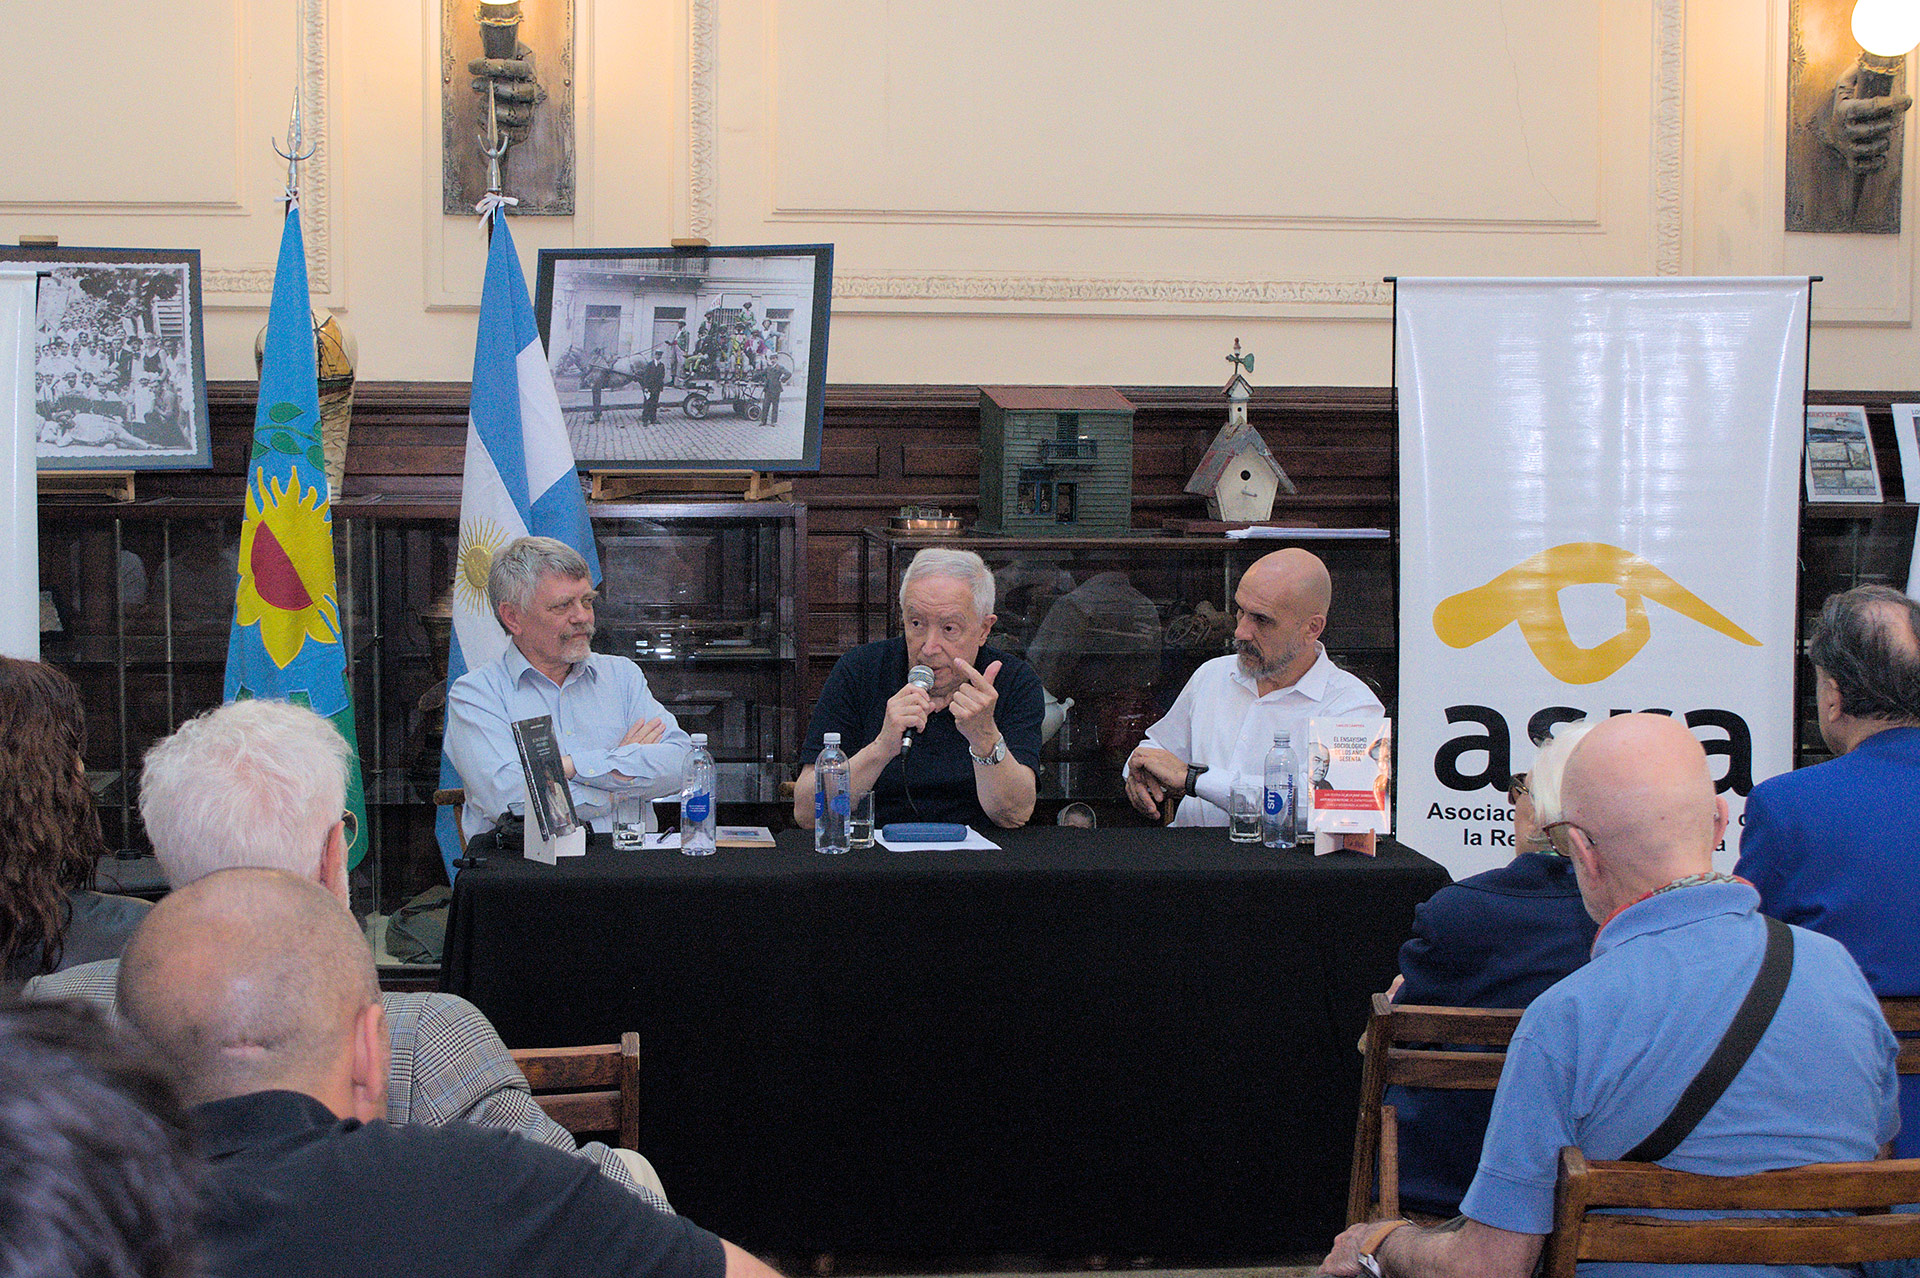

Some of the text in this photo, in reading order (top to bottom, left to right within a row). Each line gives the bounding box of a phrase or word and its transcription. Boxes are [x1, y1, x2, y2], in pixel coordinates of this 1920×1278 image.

[1434, 704, 1754, 797] asa
[1427, 802, 1516, 821] Asociac
[1463, 828, 1482, 846] la
